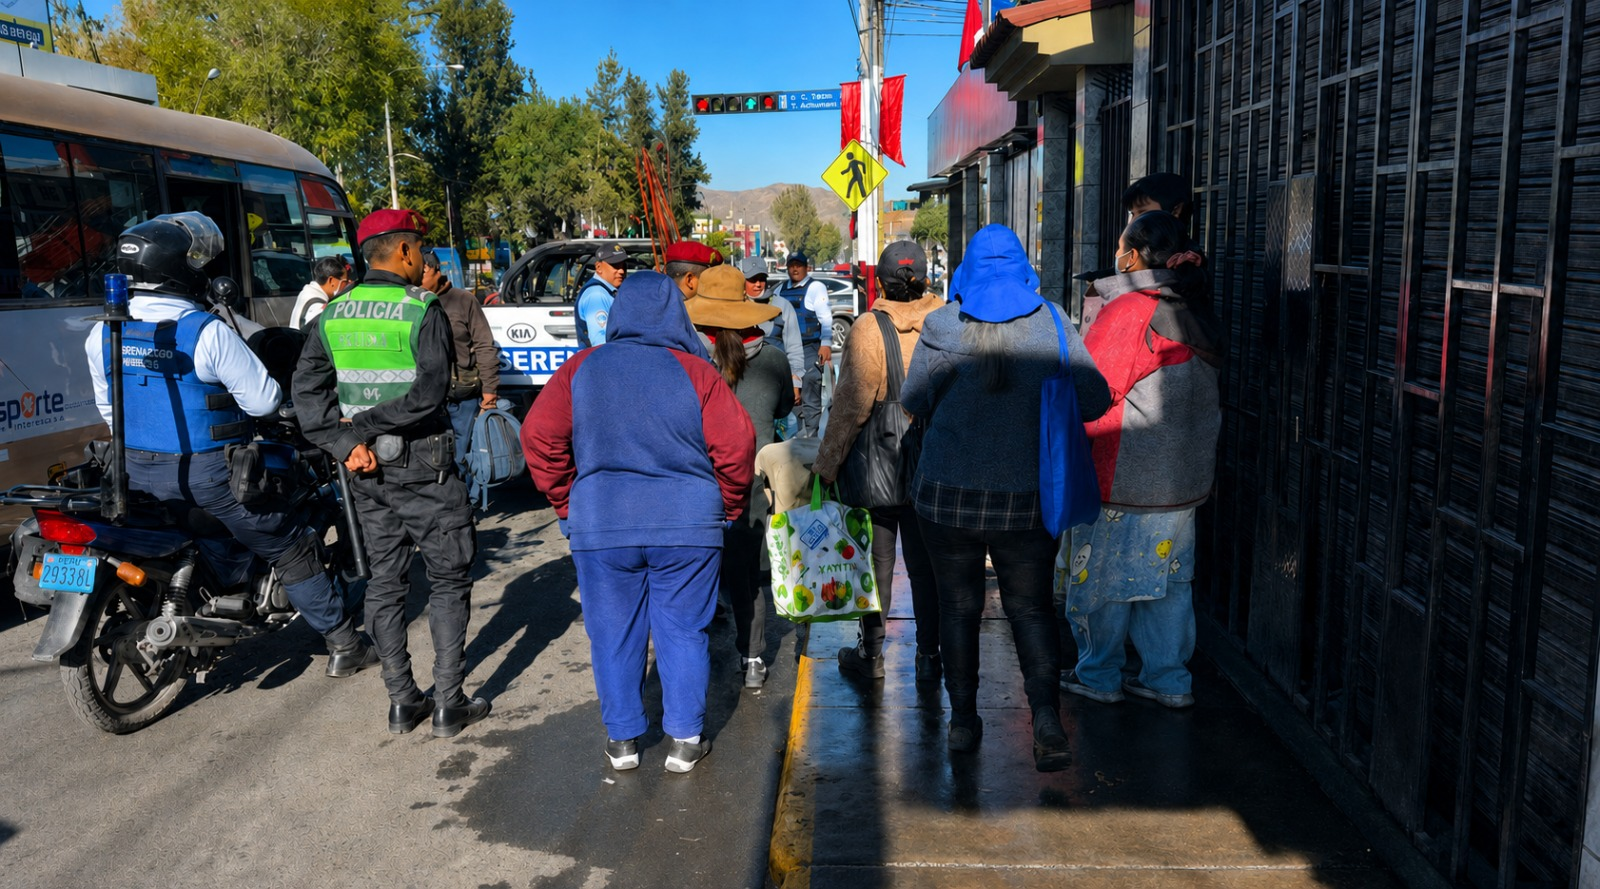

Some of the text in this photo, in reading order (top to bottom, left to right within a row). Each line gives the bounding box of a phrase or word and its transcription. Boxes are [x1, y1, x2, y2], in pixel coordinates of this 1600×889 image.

[333, 301, 403, 320] POLICIA
[511, 328, 531, 339] KIA
[42, 564, 91, 587] 29338L
